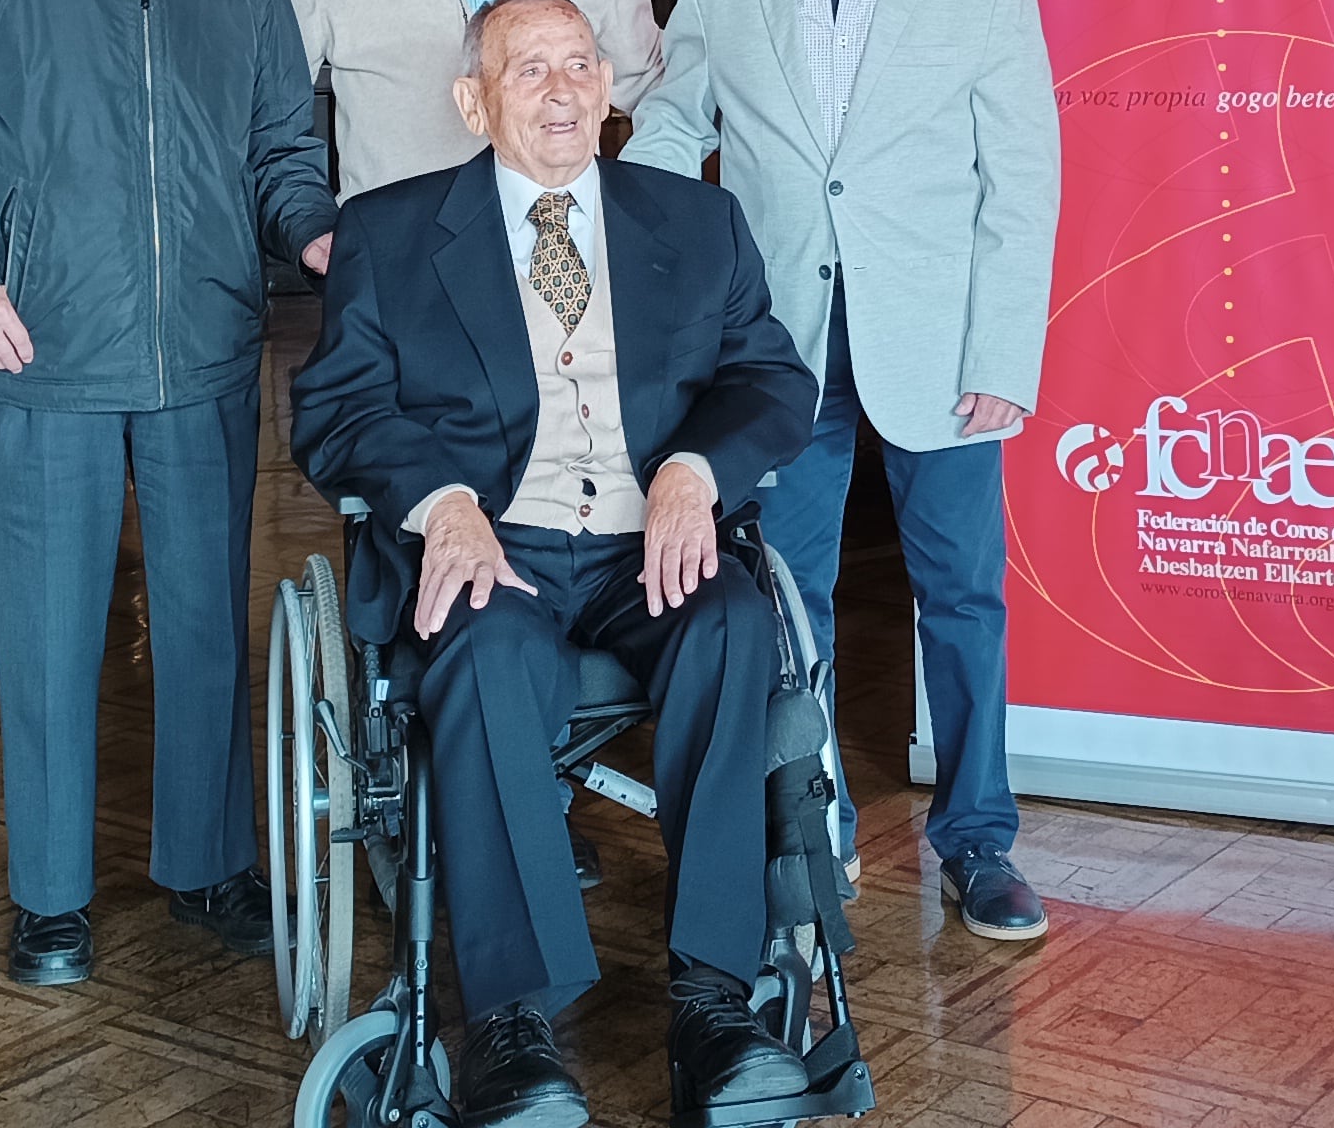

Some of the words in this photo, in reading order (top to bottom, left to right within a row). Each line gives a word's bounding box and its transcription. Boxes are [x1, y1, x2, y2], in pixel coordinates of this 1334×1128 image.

[1081, 89, 1120, 108] voz
[1125, 85, 1207, 113] propia
[1215, 90, 1278, 114] gogo
[1136, 508, 1241, 536] Federación
[1243, 516, 1268, 537] de
[1270, 518, 1329, 541] Coros
[1137, 530, 1227, 556] Navarra
[1138, 554, 1259, 581] Abesbatzen
